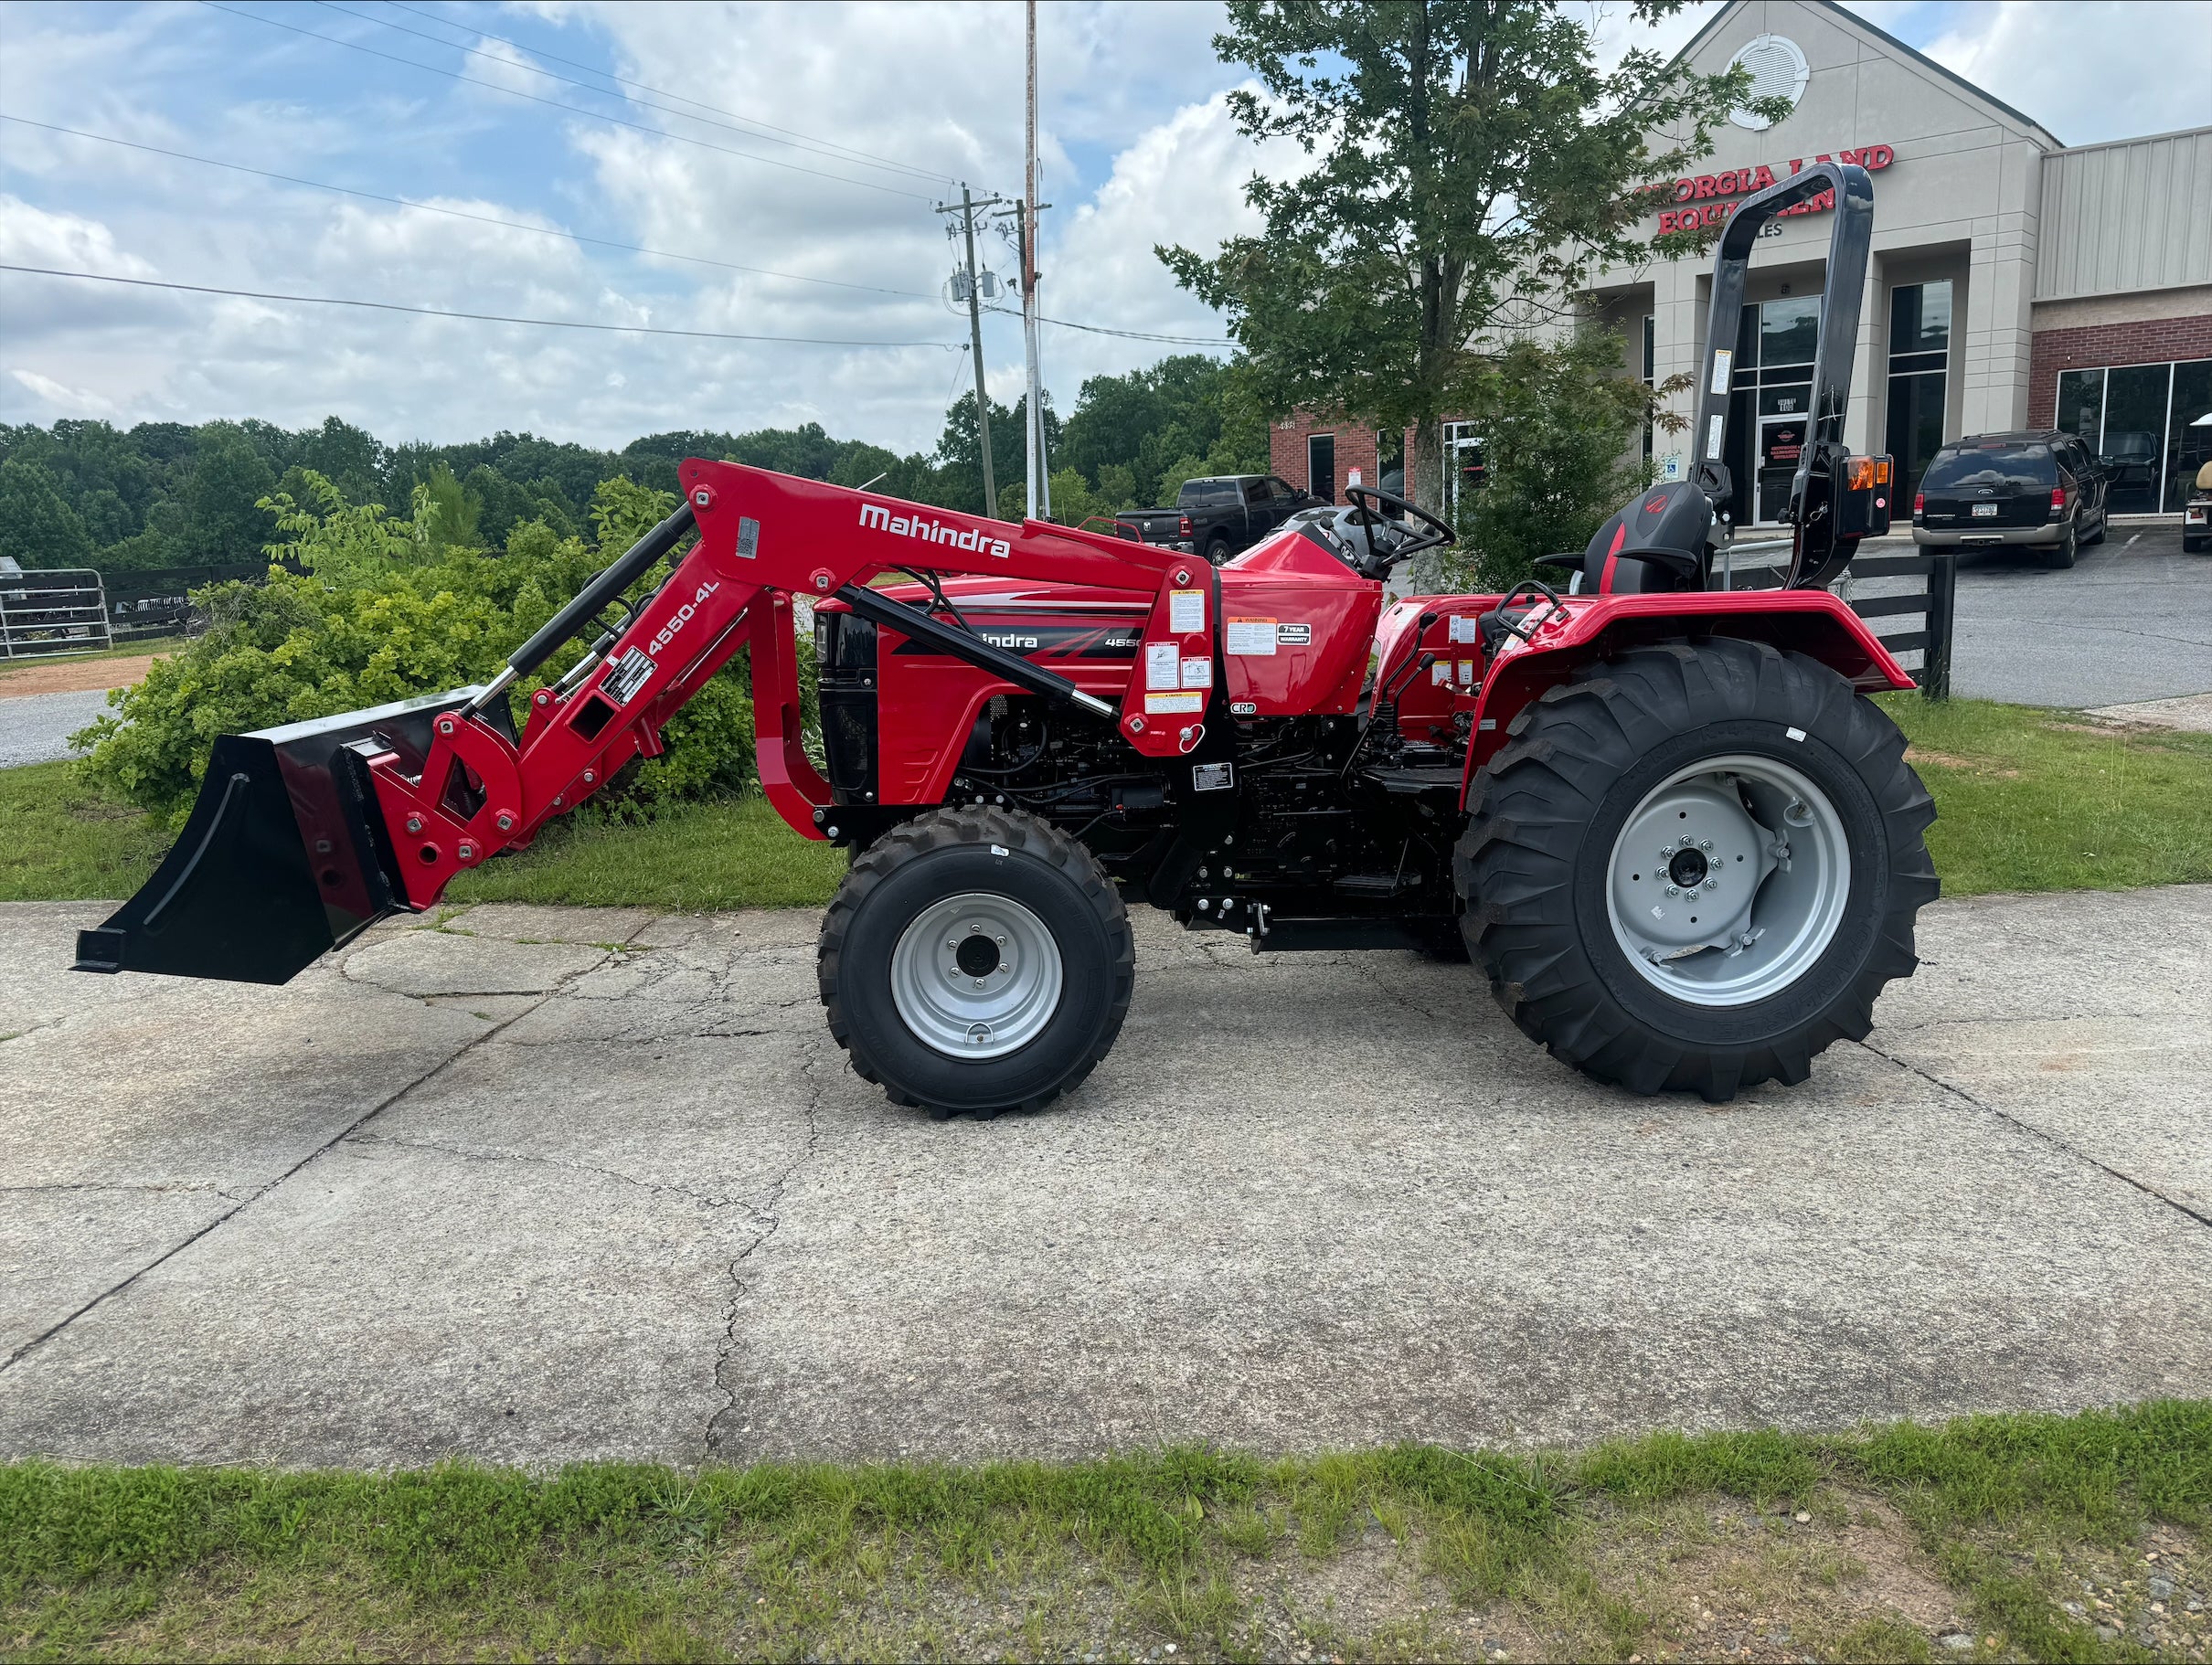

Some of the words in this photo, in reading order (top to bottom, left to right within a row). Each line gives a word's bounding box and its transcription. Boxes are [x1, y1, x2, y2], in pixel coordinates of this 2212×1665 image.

[1634, 165, 1777, 203] ORGIA
[858, 503, 1011, 558] Mahindra
[982, 633, 1038, 648] indra
[1231, 704, 1254, 713] CRD
